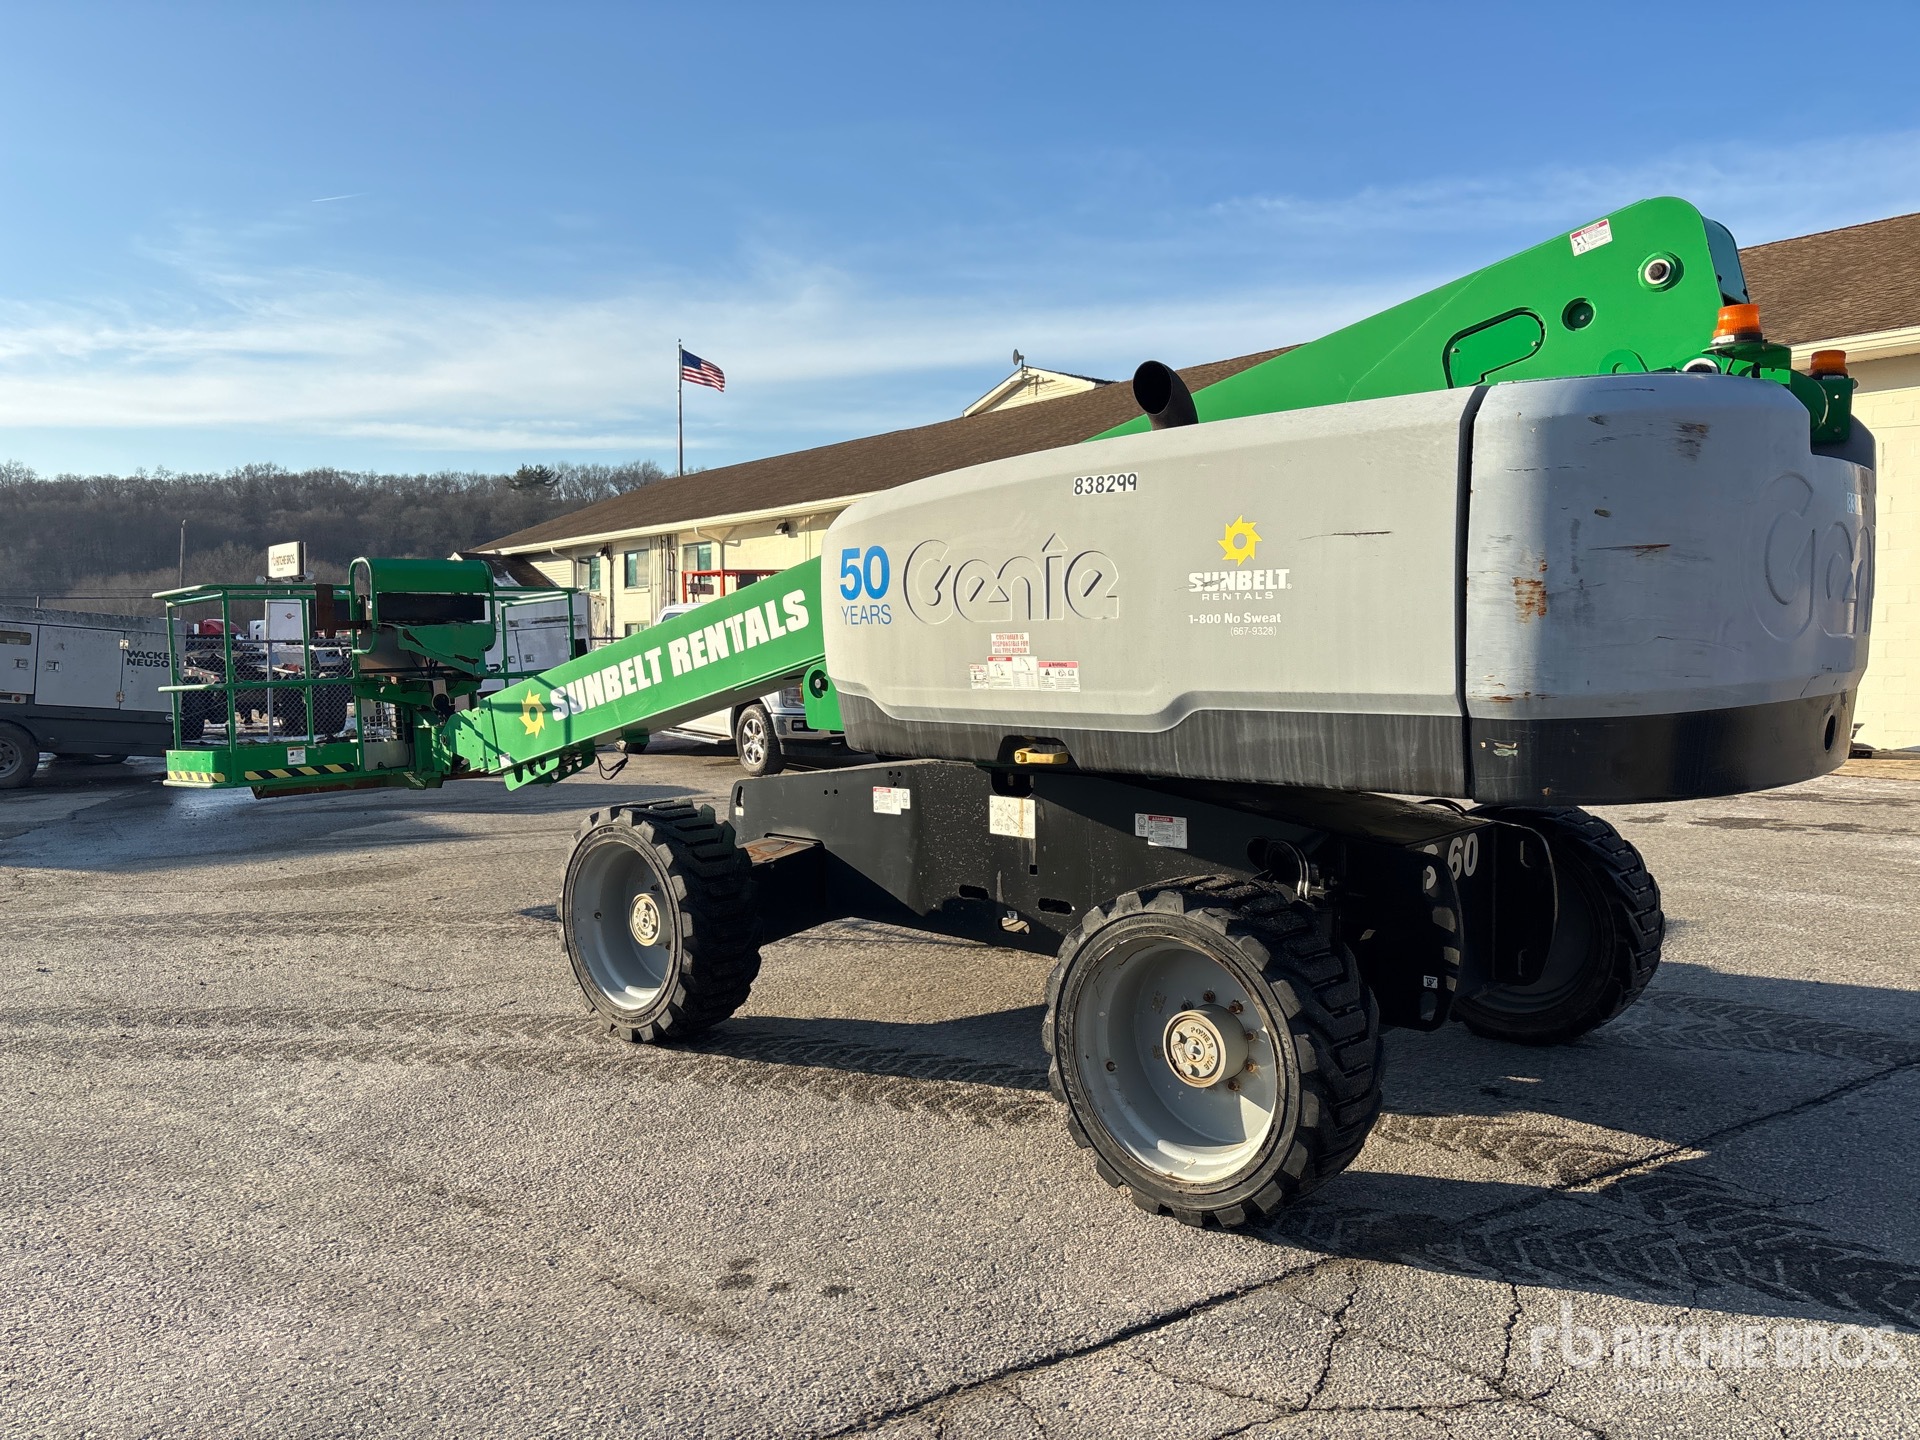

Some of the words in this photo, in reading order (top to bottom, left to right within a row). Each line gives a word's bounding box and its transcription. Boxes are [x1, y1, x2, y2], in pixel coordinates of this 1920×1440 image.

[1074, 473, 1137, 495] 838299
[840, 545, 891, 601] 50
[903, 533, 1119, 625] Genie
[1201, 591, 1274, 601] RENTALS
[841, 604, 892, 625] YEARS
[1188, 613, 1221, 624] 1-800
[1224, 613, 1240, 623] No
[1243, 612, 1282, 623] Sweat
[1230, 626, 1277, 636] (667-9328)
[550, 647, 663, 721] SUNBELT
[668, 589, 810, 677] RENTALS
